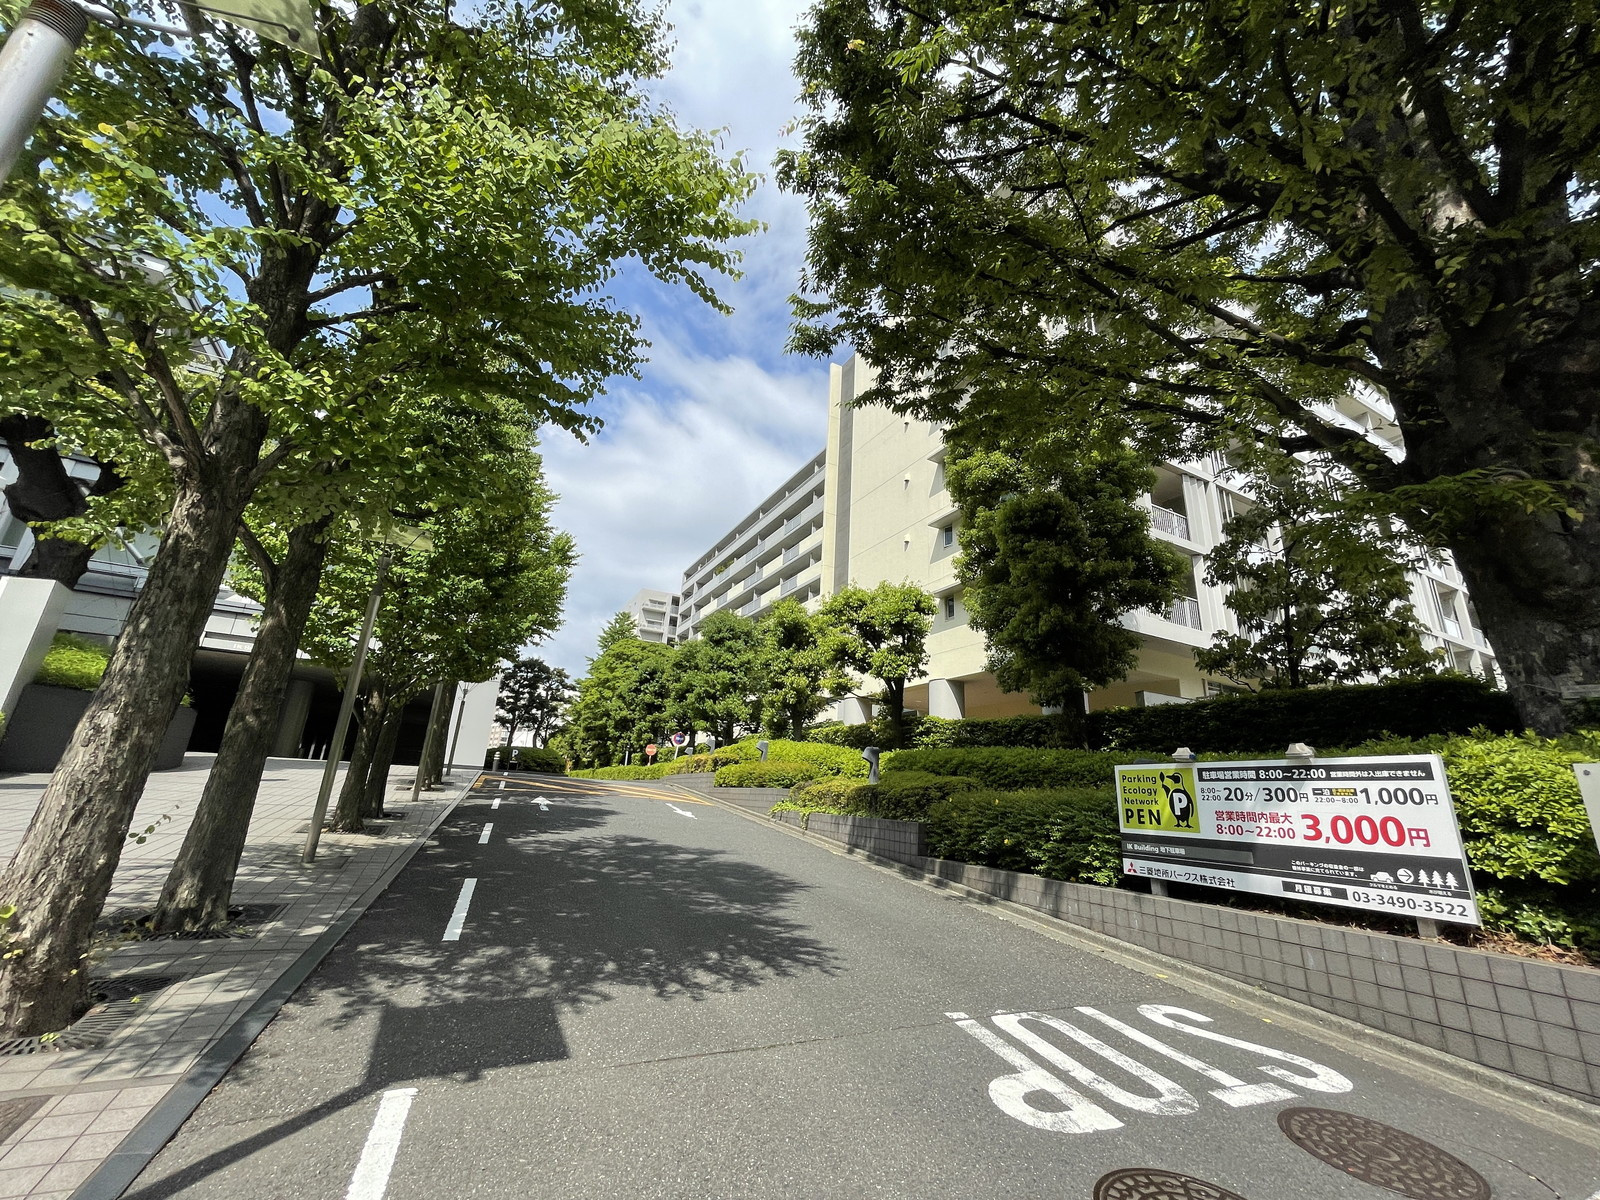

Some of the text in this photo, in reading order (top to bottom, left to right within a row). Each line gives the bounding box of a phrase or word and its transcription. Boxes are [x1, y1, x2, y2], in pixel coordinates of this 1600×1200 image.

[512, 749, 518, 757] P
[1122, 775, 1156, 784] Parking
[1202, 770, 1256, 779] 駐車場営業時間
[1123, 786, 1157, 796] Ecology
[1359, 787, 1439, 806] 1,000円
[1124, 797, 1159, 805] Network
[1172, 792, 1188, 816] P
[1125, 808, 1161, 825] PEN
[1215, 810, 1293, 825] 営業時間内最大
[1301, 813, 1431, 847] 3,000円
[1134, 844, 1159, 853] Building
[1139, 865, 1236, 888] 三菱地所パークス株式会社
[1352, 890, 1469, 917] 03-3490-3522
[944, 1003, 1355, 1135] STOP
